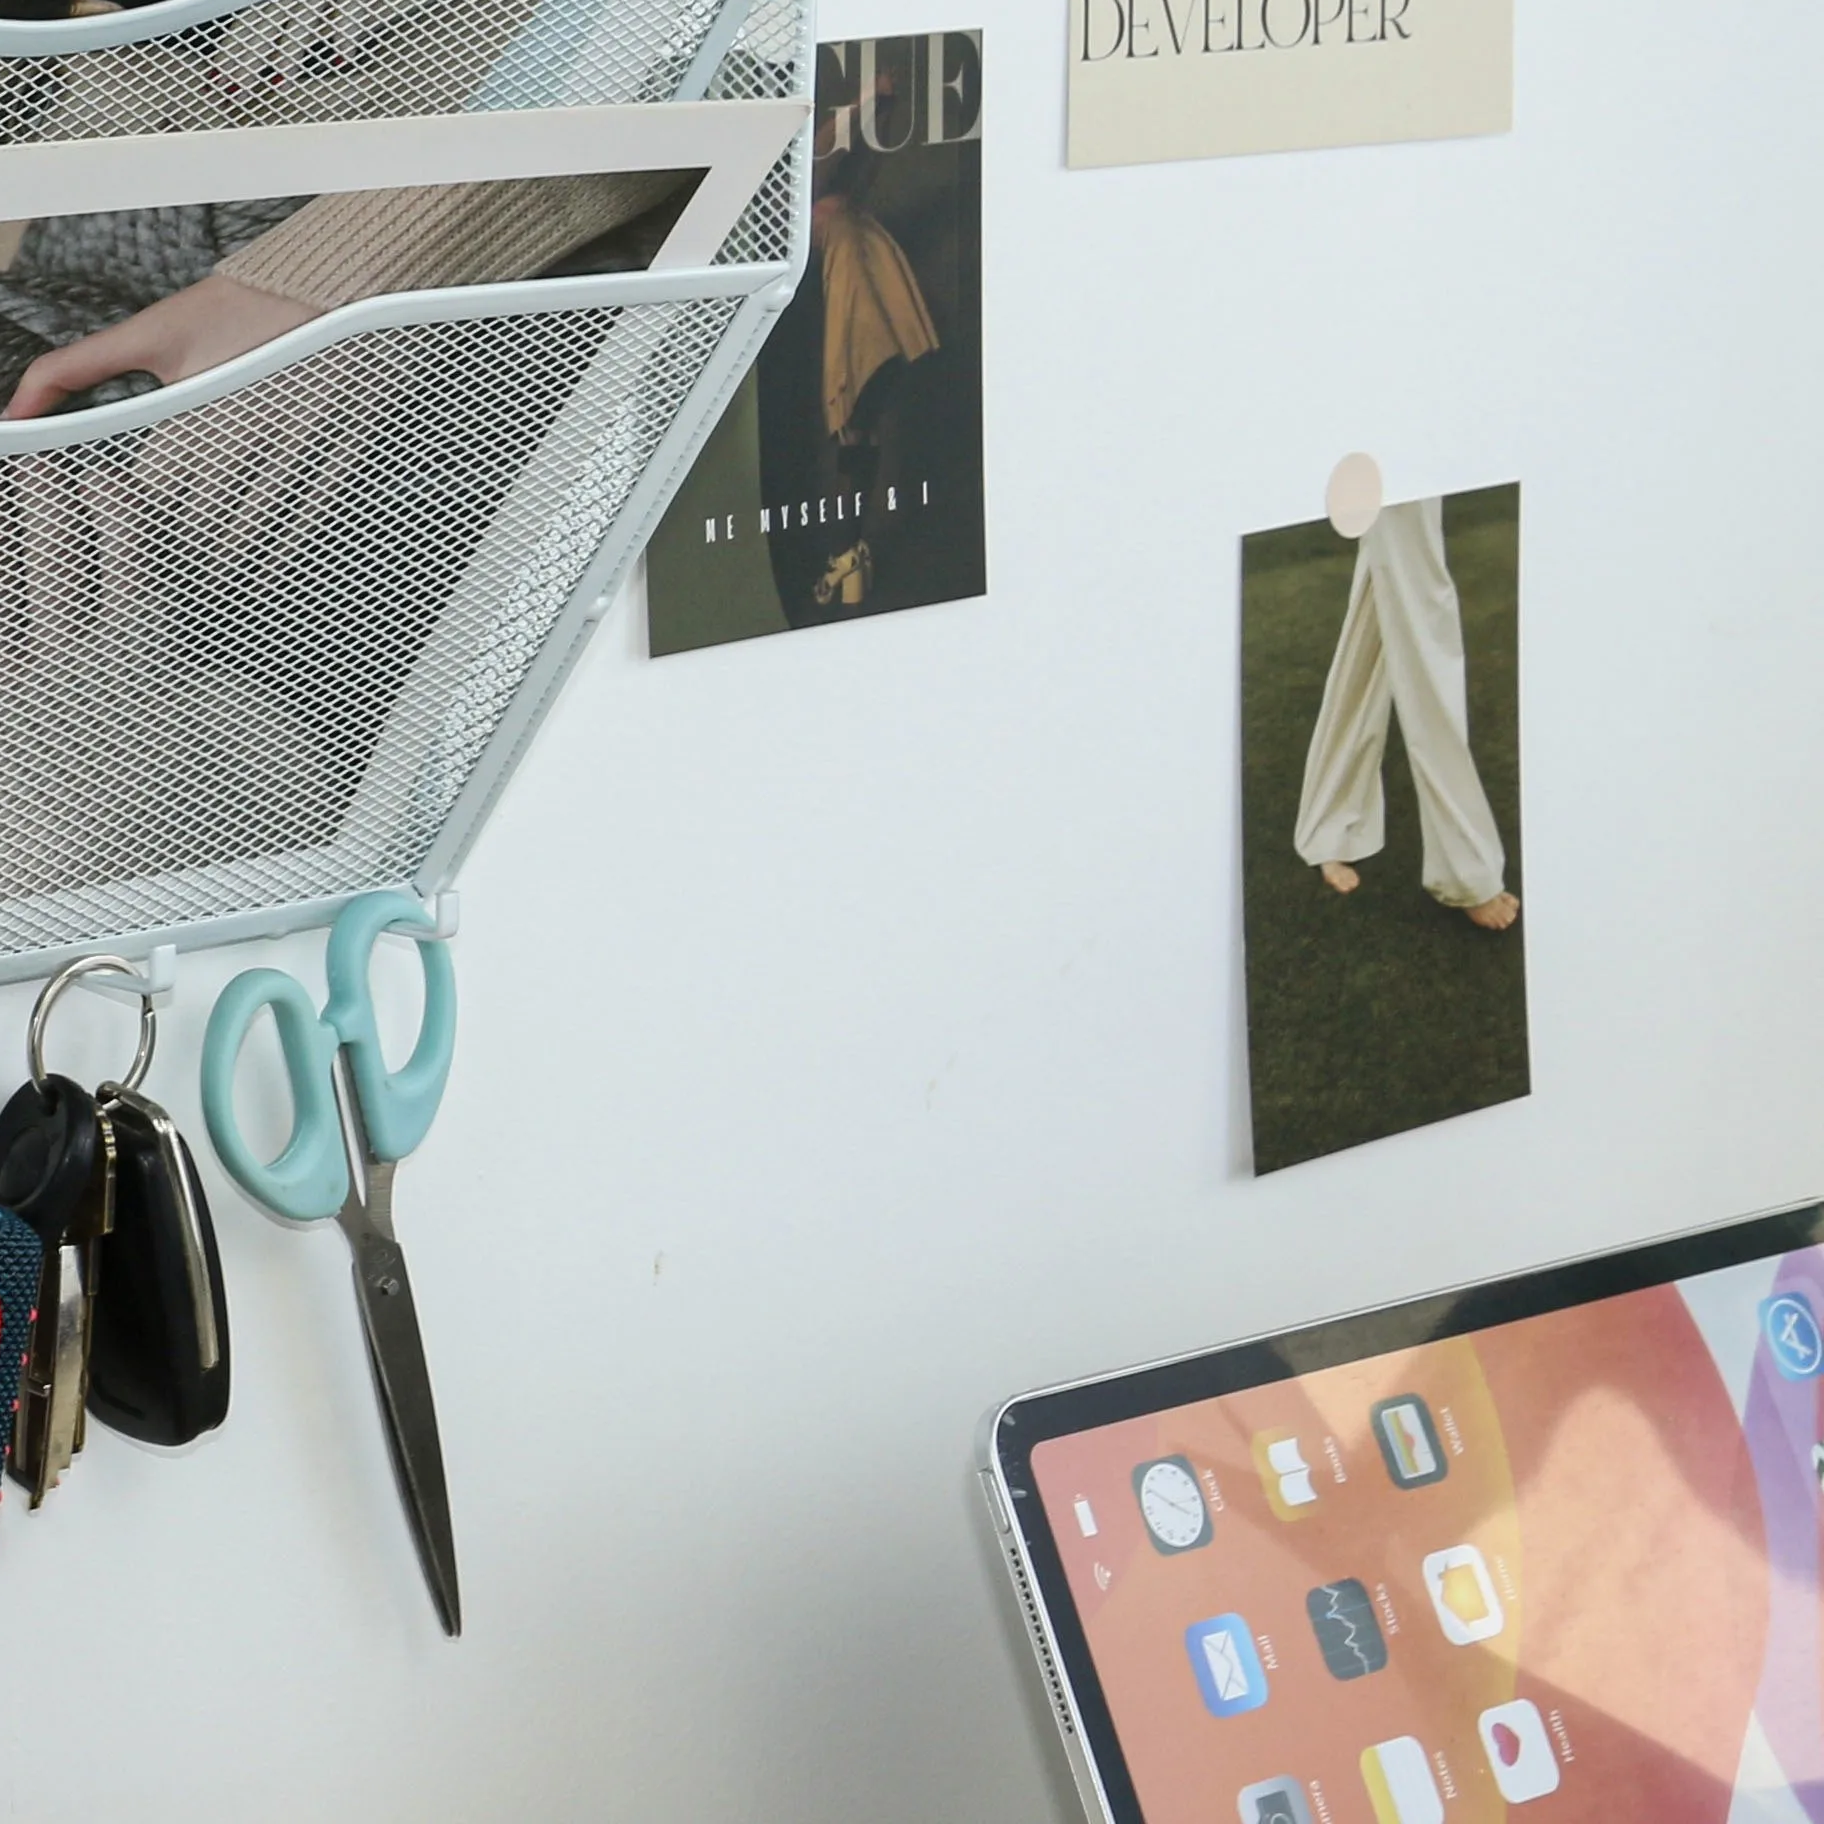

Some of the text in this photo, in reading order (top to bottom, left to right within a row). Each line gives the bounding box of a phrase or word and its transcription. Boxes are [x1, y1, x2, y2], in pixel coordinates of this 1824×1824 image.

[814, 28, 981, 162] GUE
[705, 481, 929, 544] ME MYSELF & I
[1440, 1406, 1464, 1456] Wallet
[1201, 1469, 1224, 1512] Clock
[1375, 1582, 1401, 1635] Stocks
[1257, 1634, 1280, 1670] Mail
[1548, 1708, 1576, 1764] Health
[1433, 1750, 1459, 1801] Notes
